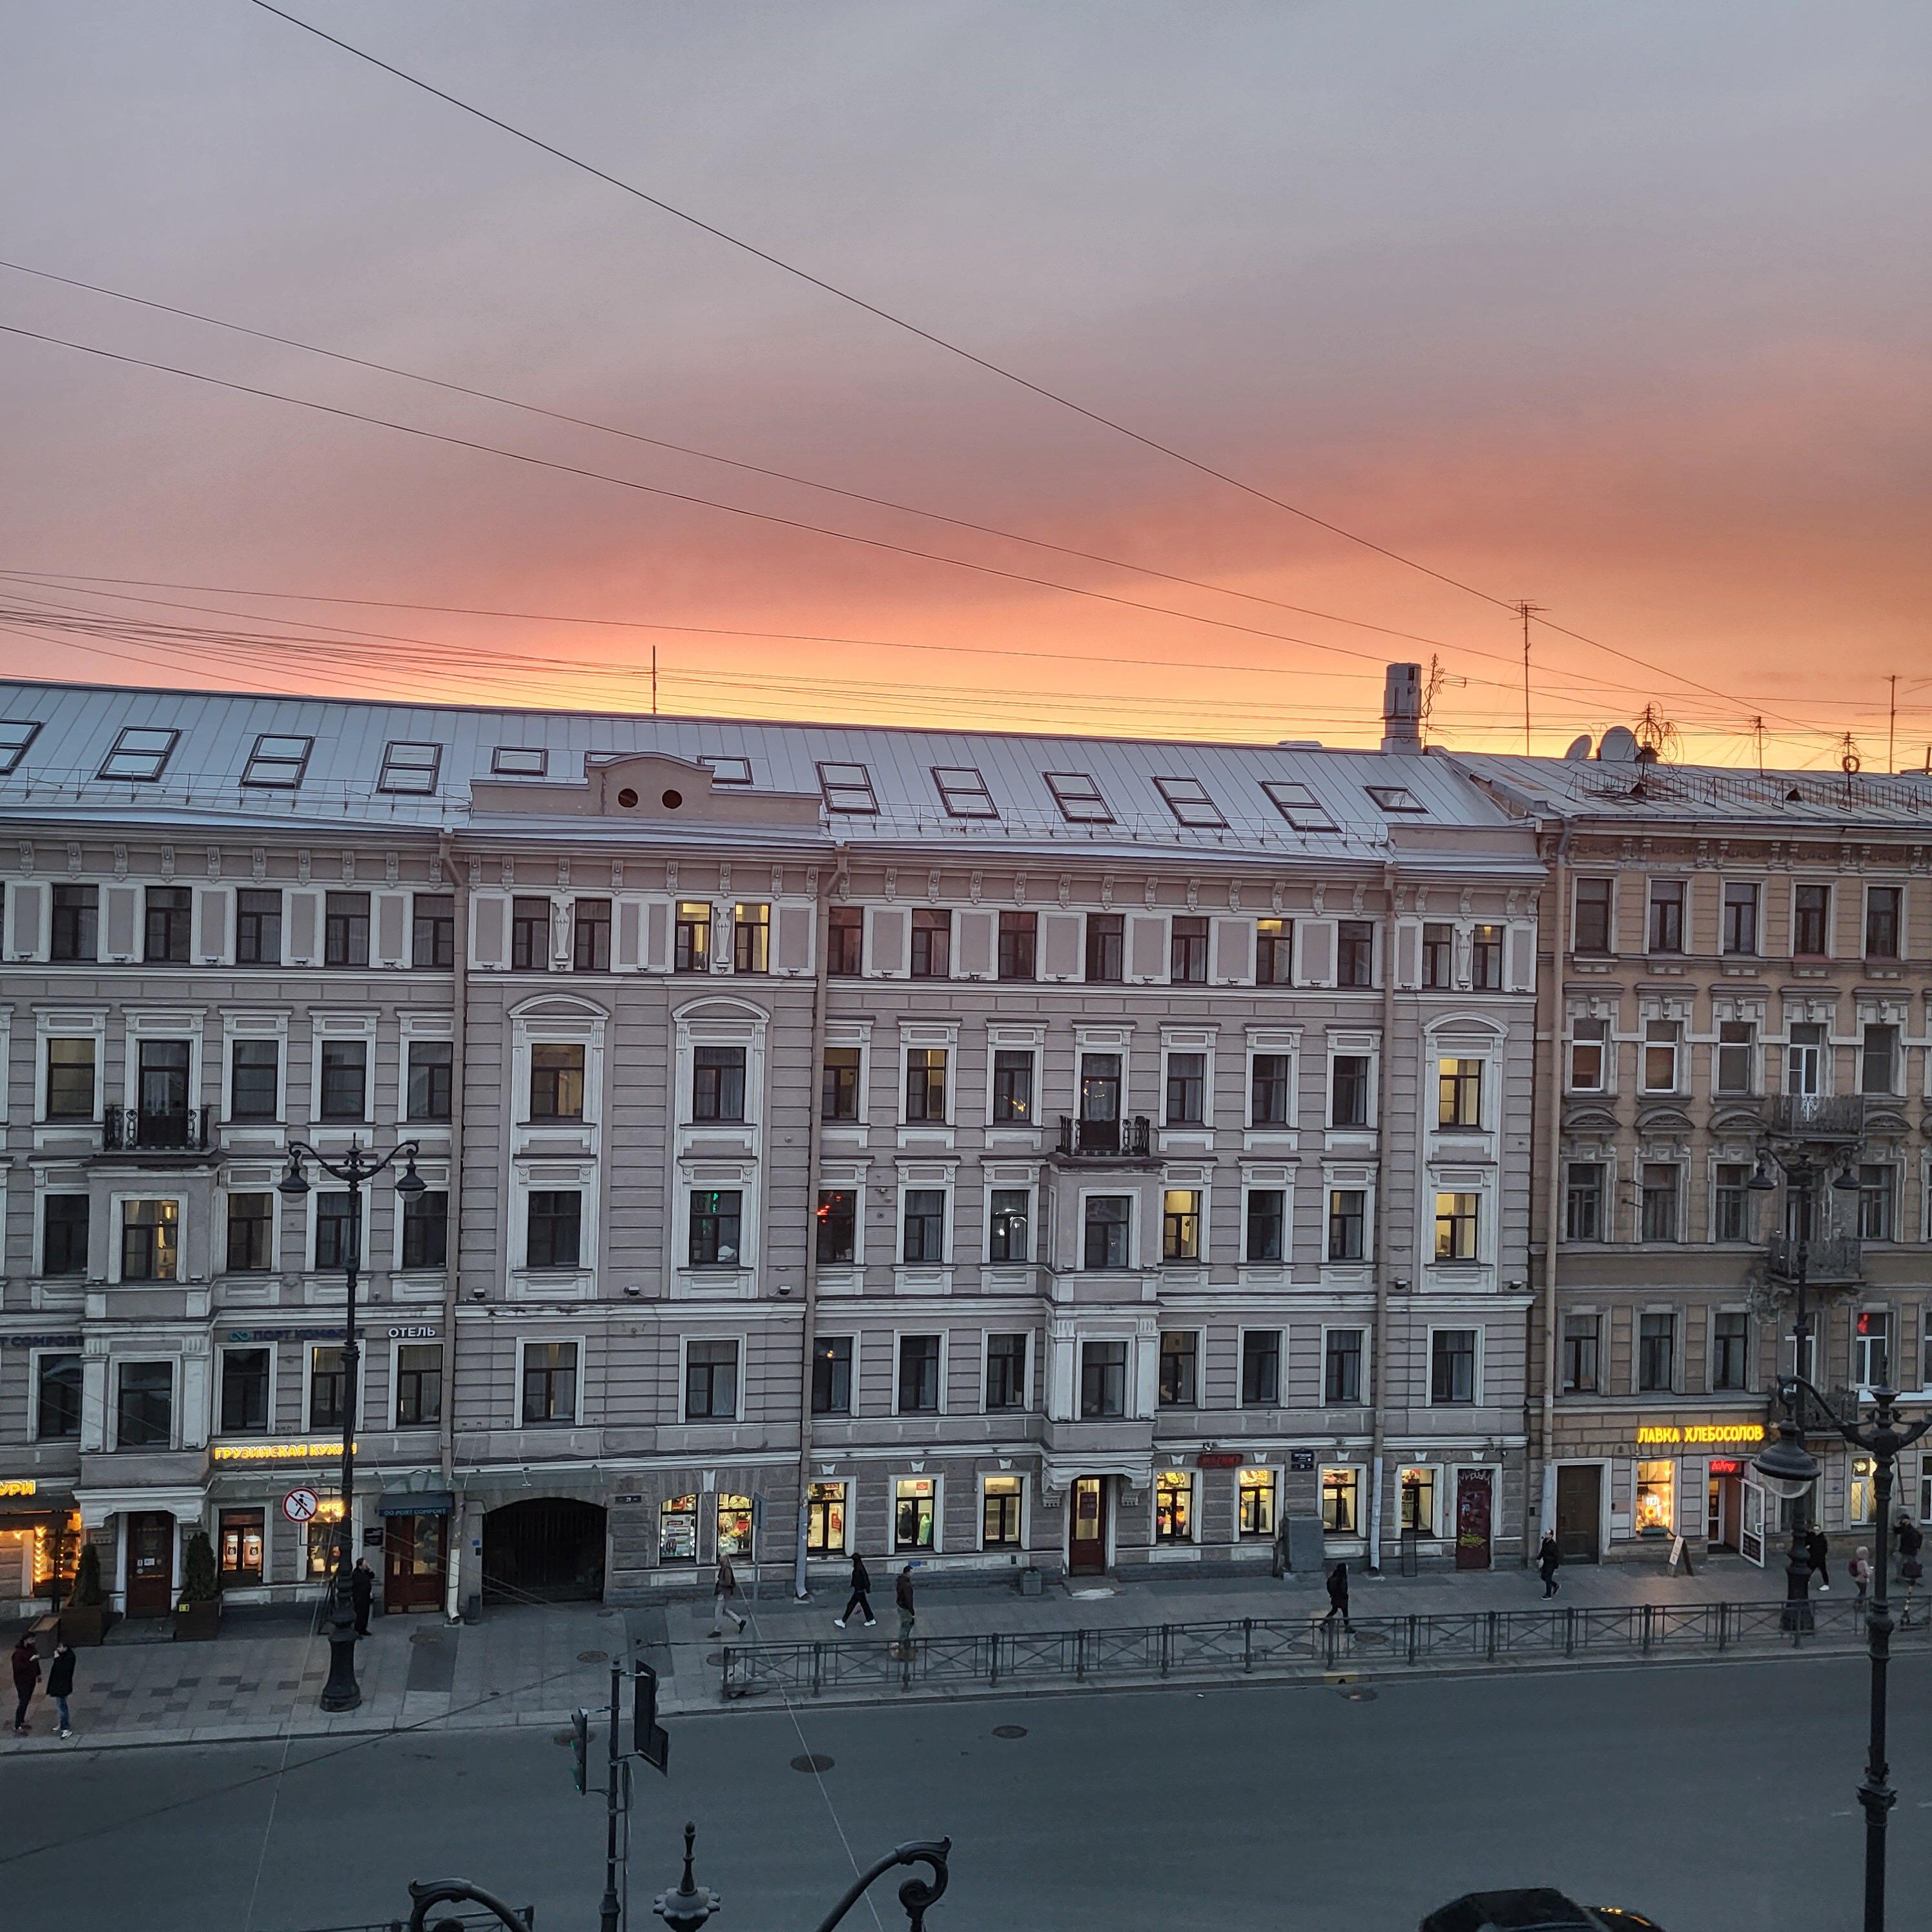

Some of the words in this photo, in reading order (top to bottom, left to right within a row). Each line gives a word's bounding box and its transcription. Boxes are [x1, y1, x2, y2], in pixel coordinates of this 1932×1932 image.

[295, 1328, 365, 1339] КОМФОТ
[388, 1327, 436, 1338] ОТЕЛЬ
[1638, 1427, 1680, 1443] ЛАВКА
[1684, 1425, 1764, 1443] ХЛЕБОСОЛОВ
[214, 1444, 307, 1460] ГРУЗИНСКАЯ
